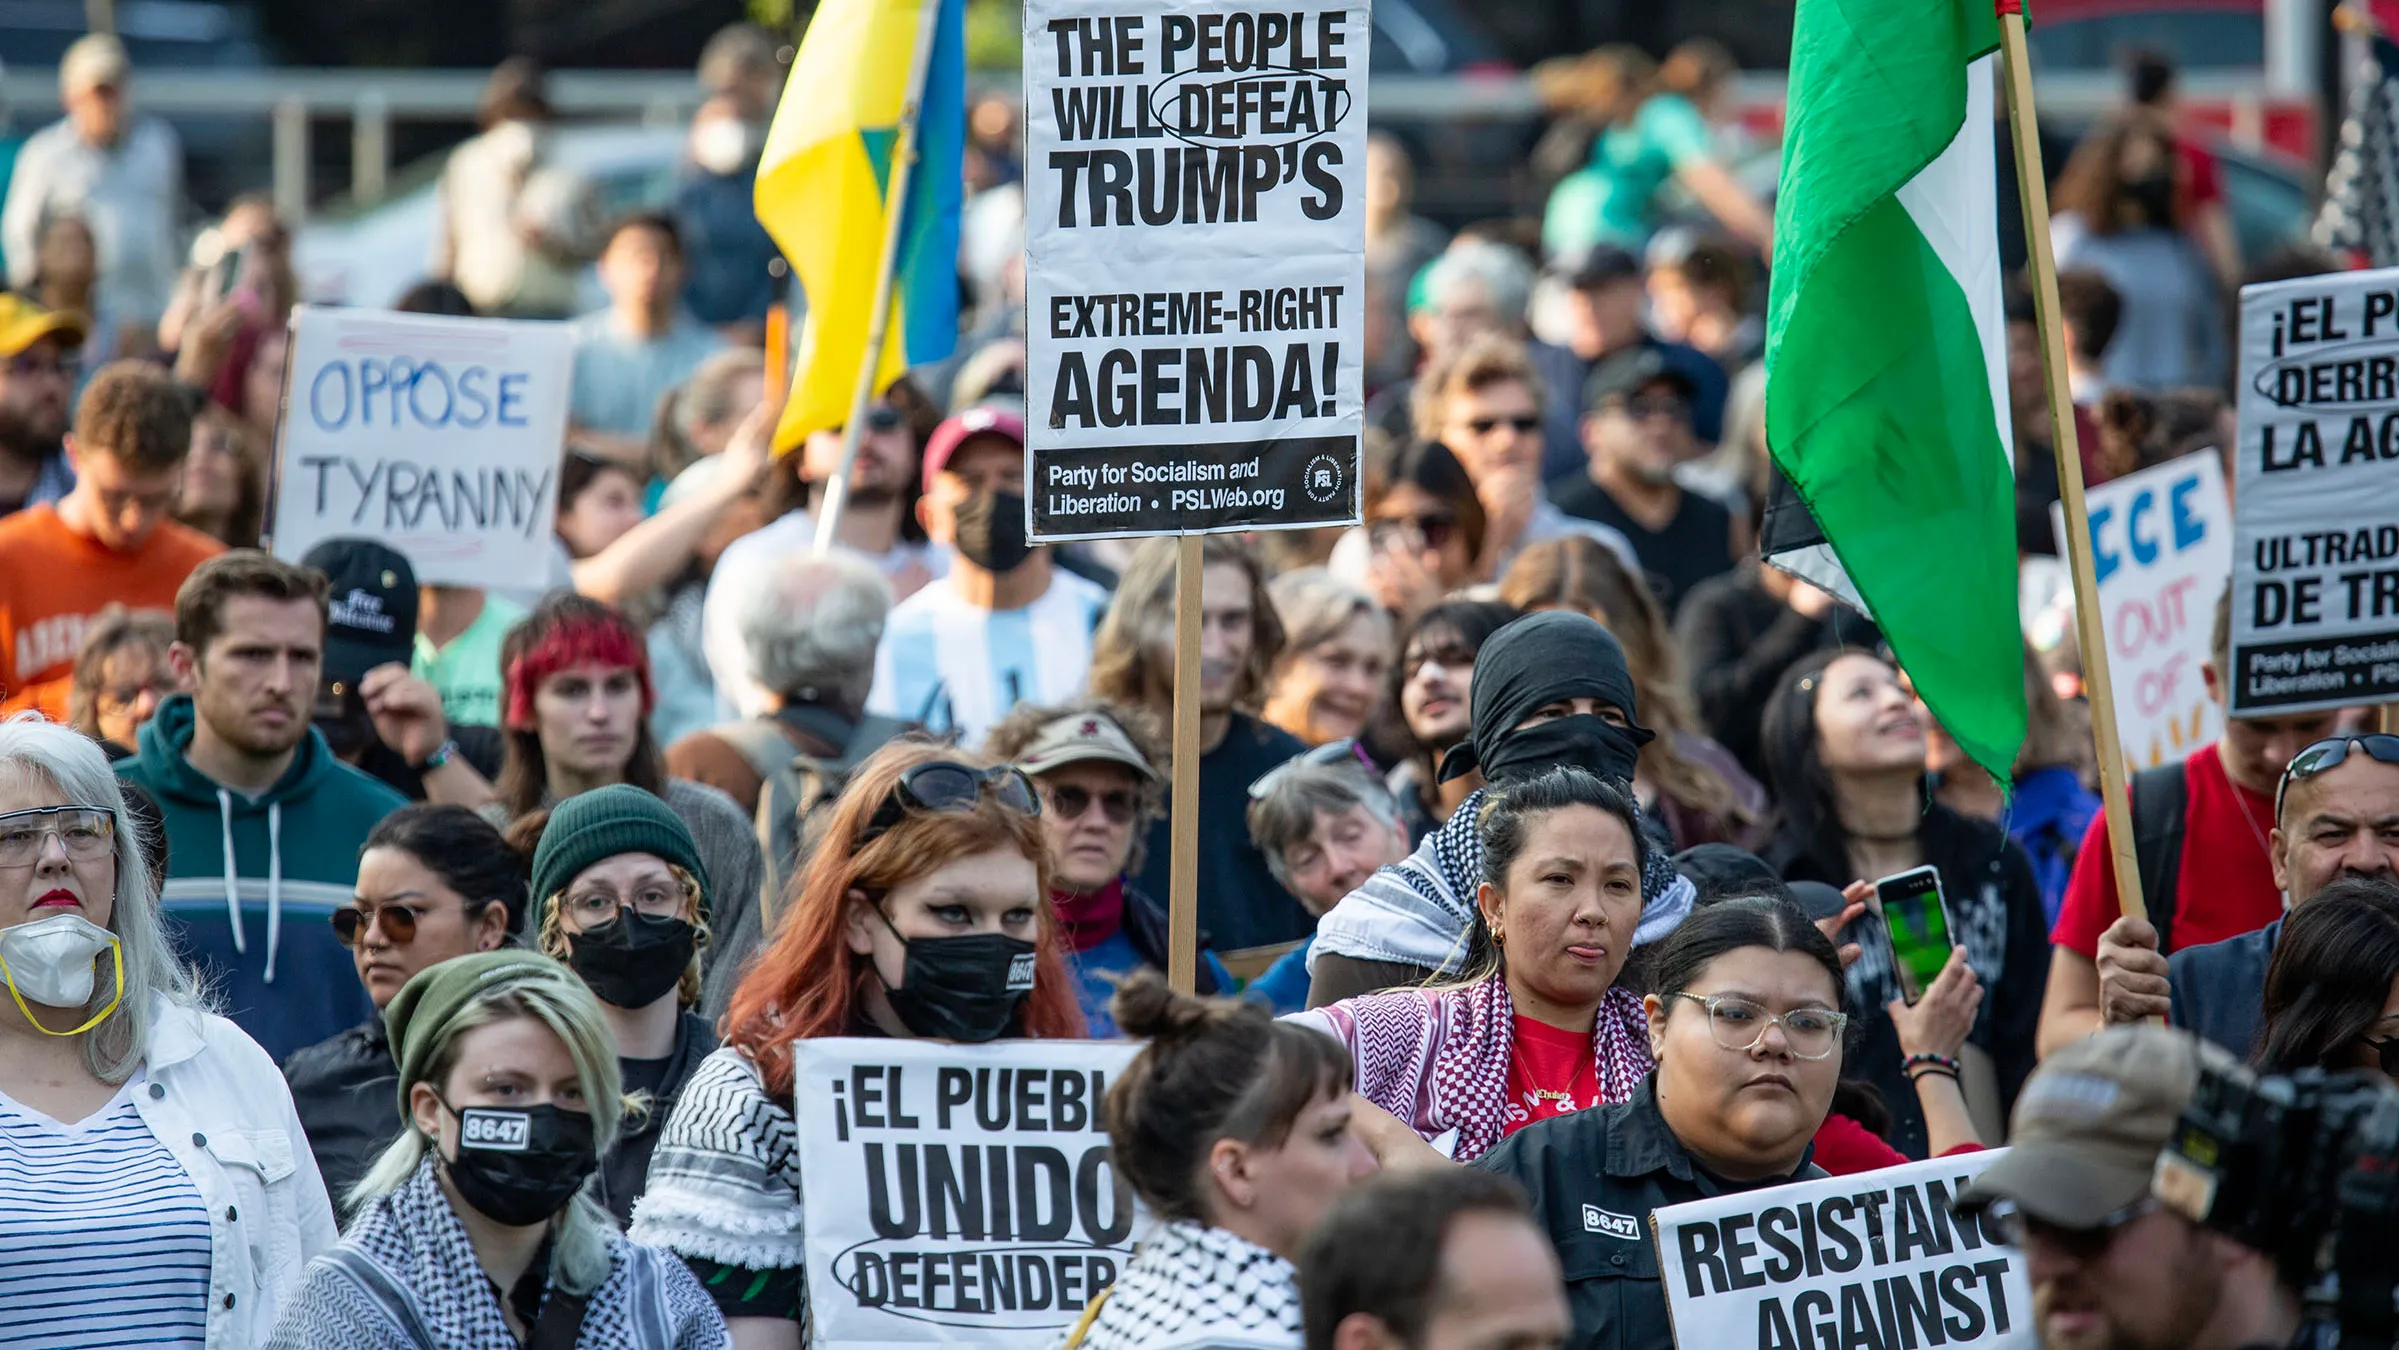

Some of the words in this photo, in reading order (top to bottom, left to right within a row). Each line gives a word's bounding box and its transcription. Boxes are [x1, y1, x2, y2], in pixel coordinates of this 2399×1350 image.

[1047, 16, 1144, 77] THE
[1161, 11, 1347, 74] PEOPLE
[1052, 85, 1163, 141] WILL
[1179, 79, 1346, 137] DEFEAT
[1049, 141, 1343, 228] TRUMP'S
[1050, 286, 1344, 339] EXTREME-RIGHT
[2273, 296, 2347, 357] ¡EL
[2363, 289, 2399, 337] P
[310, 355, 530, 434] OPPOSE
[1049, 341, 1340, 429] AGENDA!
[1049, 465, 1097, 490] Party
[1101, 463, 1127, 484] for
[1131, 459, 1225, 483] Socialism
[1229, 457, 1259, 479] and
[2262, 420, 2325, 473] LA
[299, 456, 552, 539] TYRANNY
[1049, 494, 1141, 515] Liberation
[1172, 487, 1285, 511] PSLWeb.org
[1314, 473, 1332, 487] PSL
[2087, 475, 2206, 587] ICE
[2113, 574, 2198, 658] OUT
[2254, 576, 2321, 628] DE
[2340, 570, 2399, 620] TR
[2133, 651, 2190, 717] OF
[2250, 669, 2346, 696] Liberation
[2251, 652, 2300, 674] Party
[2304, 648, 2332, 669] for
[466, 1117, 525, 1141] 8647
[832, 1065, 919, 1142] ¡EL
[863, 1142, 1134, 1247] UNIDO
[1586, 1210, 1634, 1234] 8647
[1758, 1258, 2010, 1350] AGAINST
